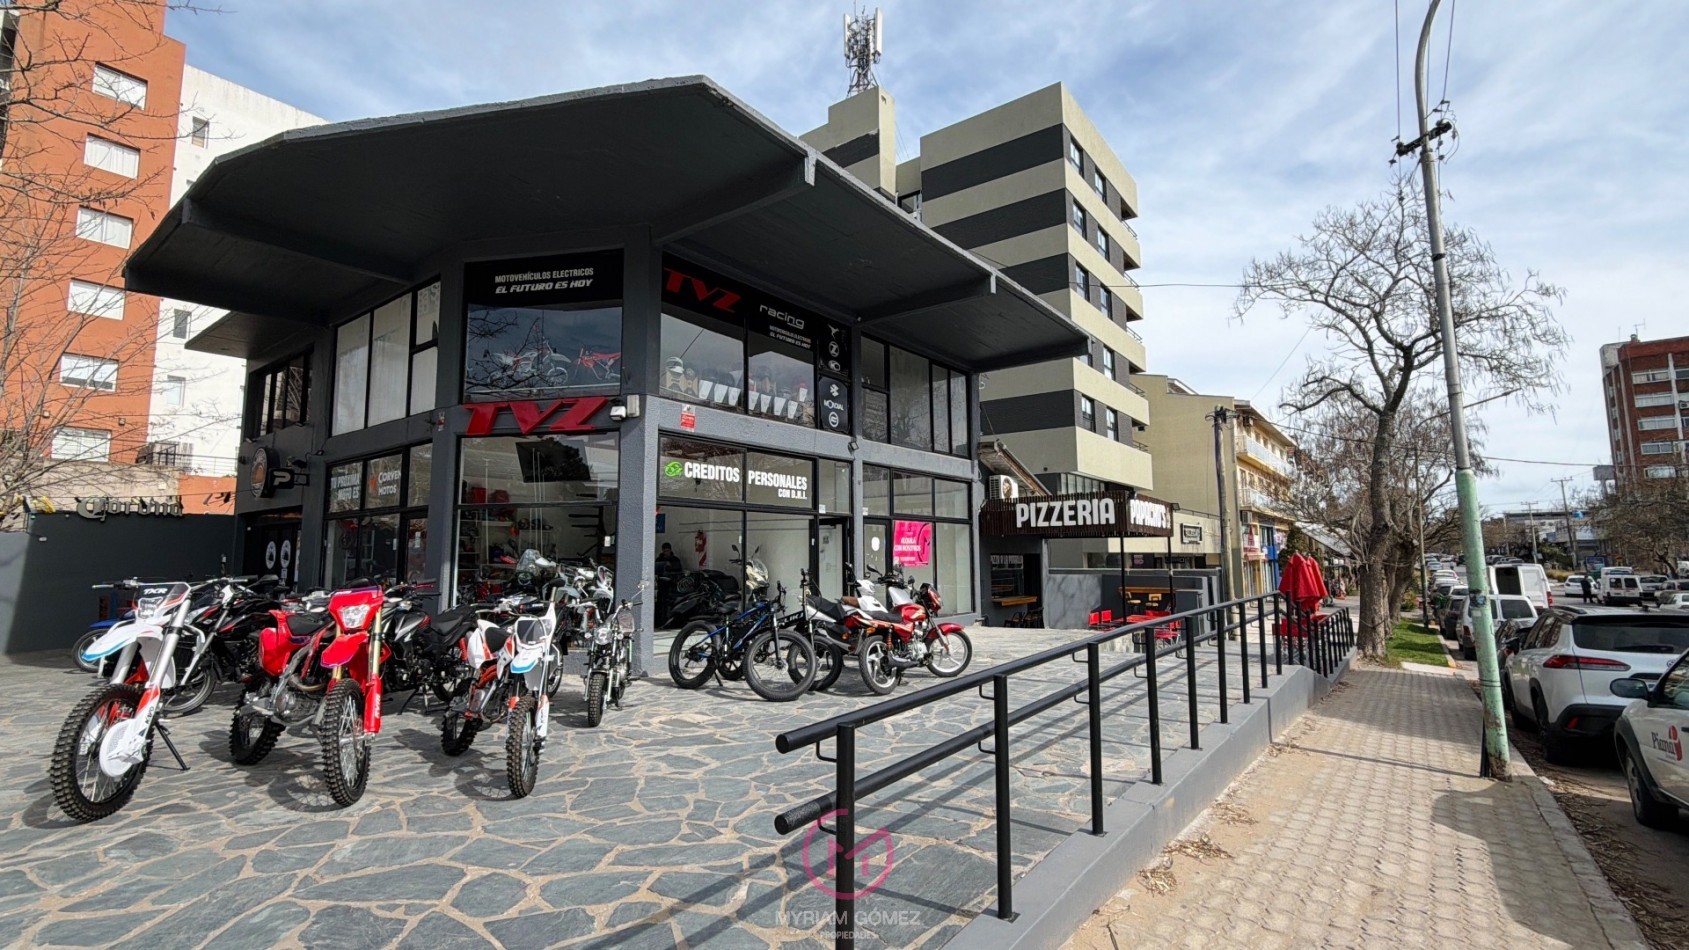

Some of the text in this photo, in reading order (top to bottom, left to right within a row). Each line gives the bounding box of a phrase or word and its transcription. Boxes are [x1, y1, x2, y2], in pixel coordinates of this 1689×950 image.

[495, 267, 594, 283] MOTOVEHÍCULOS ELECTRICOS
[495, 279, 593, 294] EL FUTURO ES HOY
[664, 267, 741, 312] TVZ
[760, 304, 804, 329] racing
[464, 397, 608, 436] TVZ
[684, 461, 808, 491] CREDITOS PERSONALES
[378, 485, 397, 496] MOTOS
[1016, 498, 1116, 528] PIZZERIA
